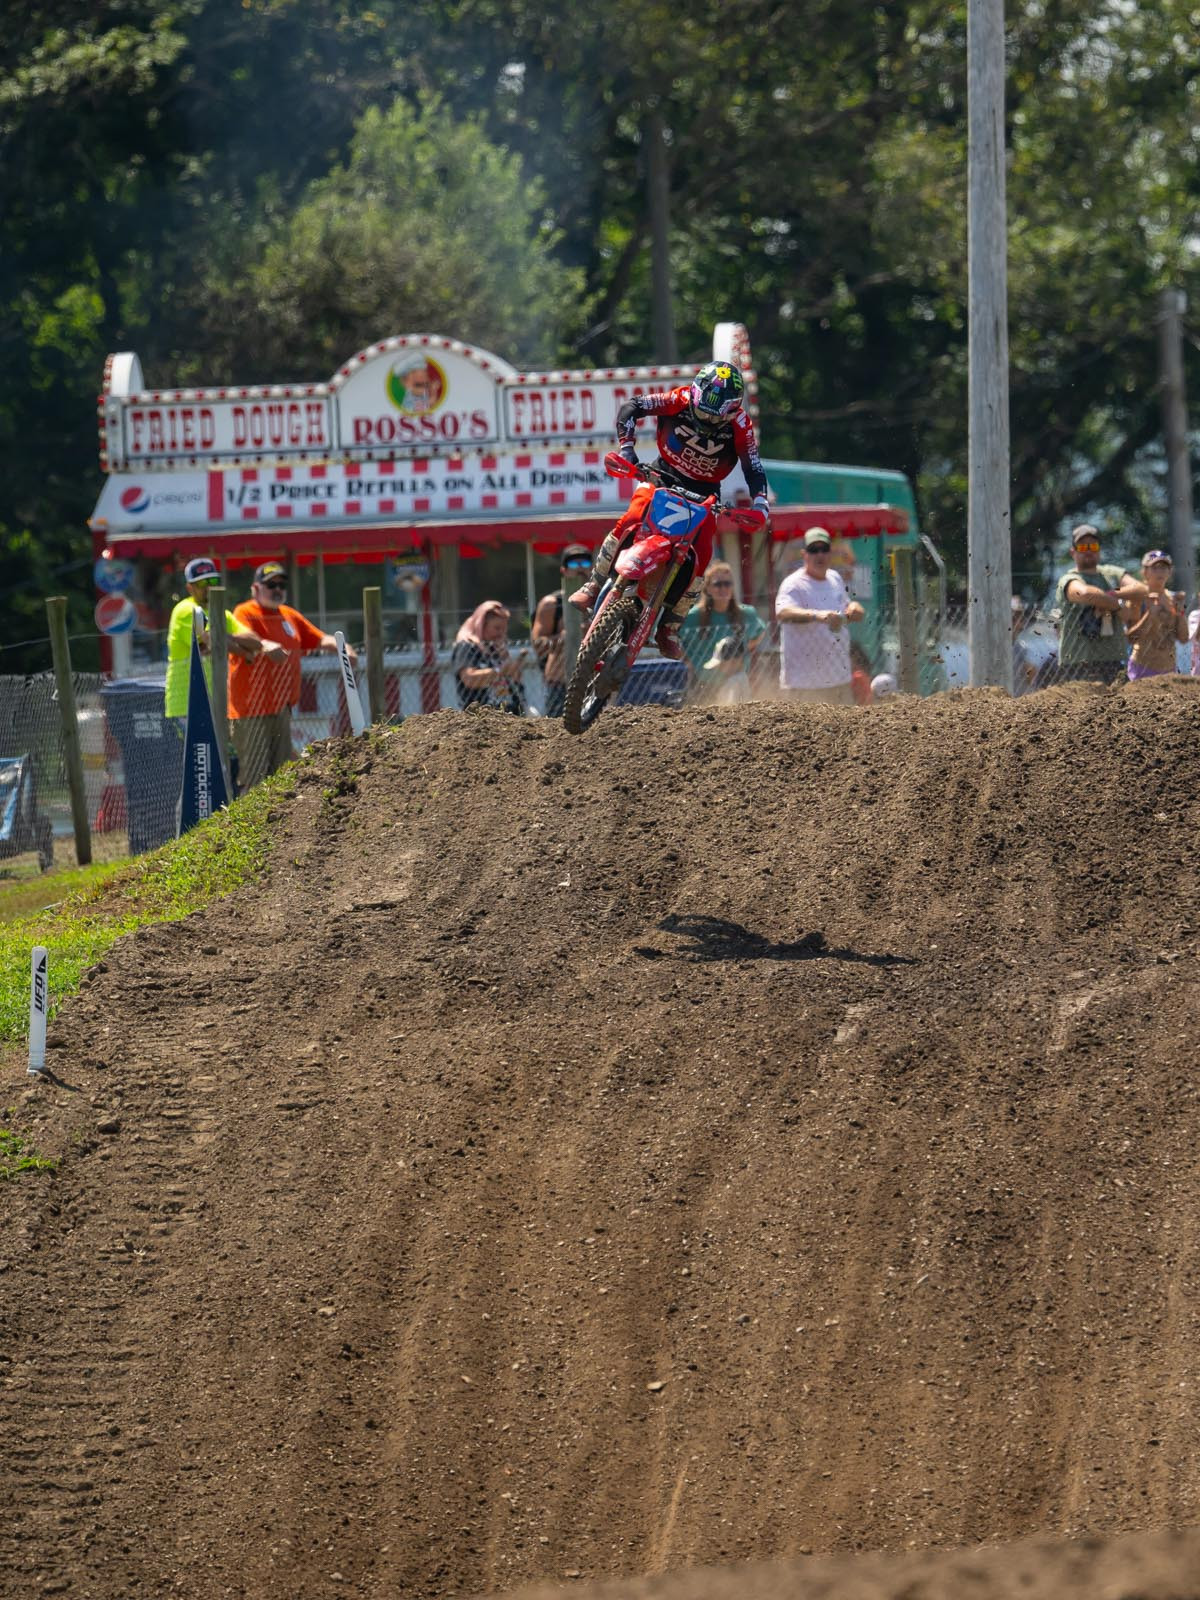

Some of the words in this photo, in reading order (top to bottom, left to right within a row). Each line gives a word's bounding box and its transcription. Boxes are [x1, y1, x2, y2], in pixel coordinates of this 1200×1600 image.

[131, 408, 215, 452] FRIED
[232, 402, 324, 448] DOUGH
[354, 410, 489, 444] ROSSO'S
[512, 389, 596, 435] FRIED
[674, 425, 725, 456] FLY
[663, 444, 713, 478] HONDA
[227, 484, 261, 508] 1/2
[657, 500, 696, 529] 7
[342, 655, 356, 690] UFO
[196, 743, 209, 820] MOTOCROS
[34, 972, 43, 1014] UFO
